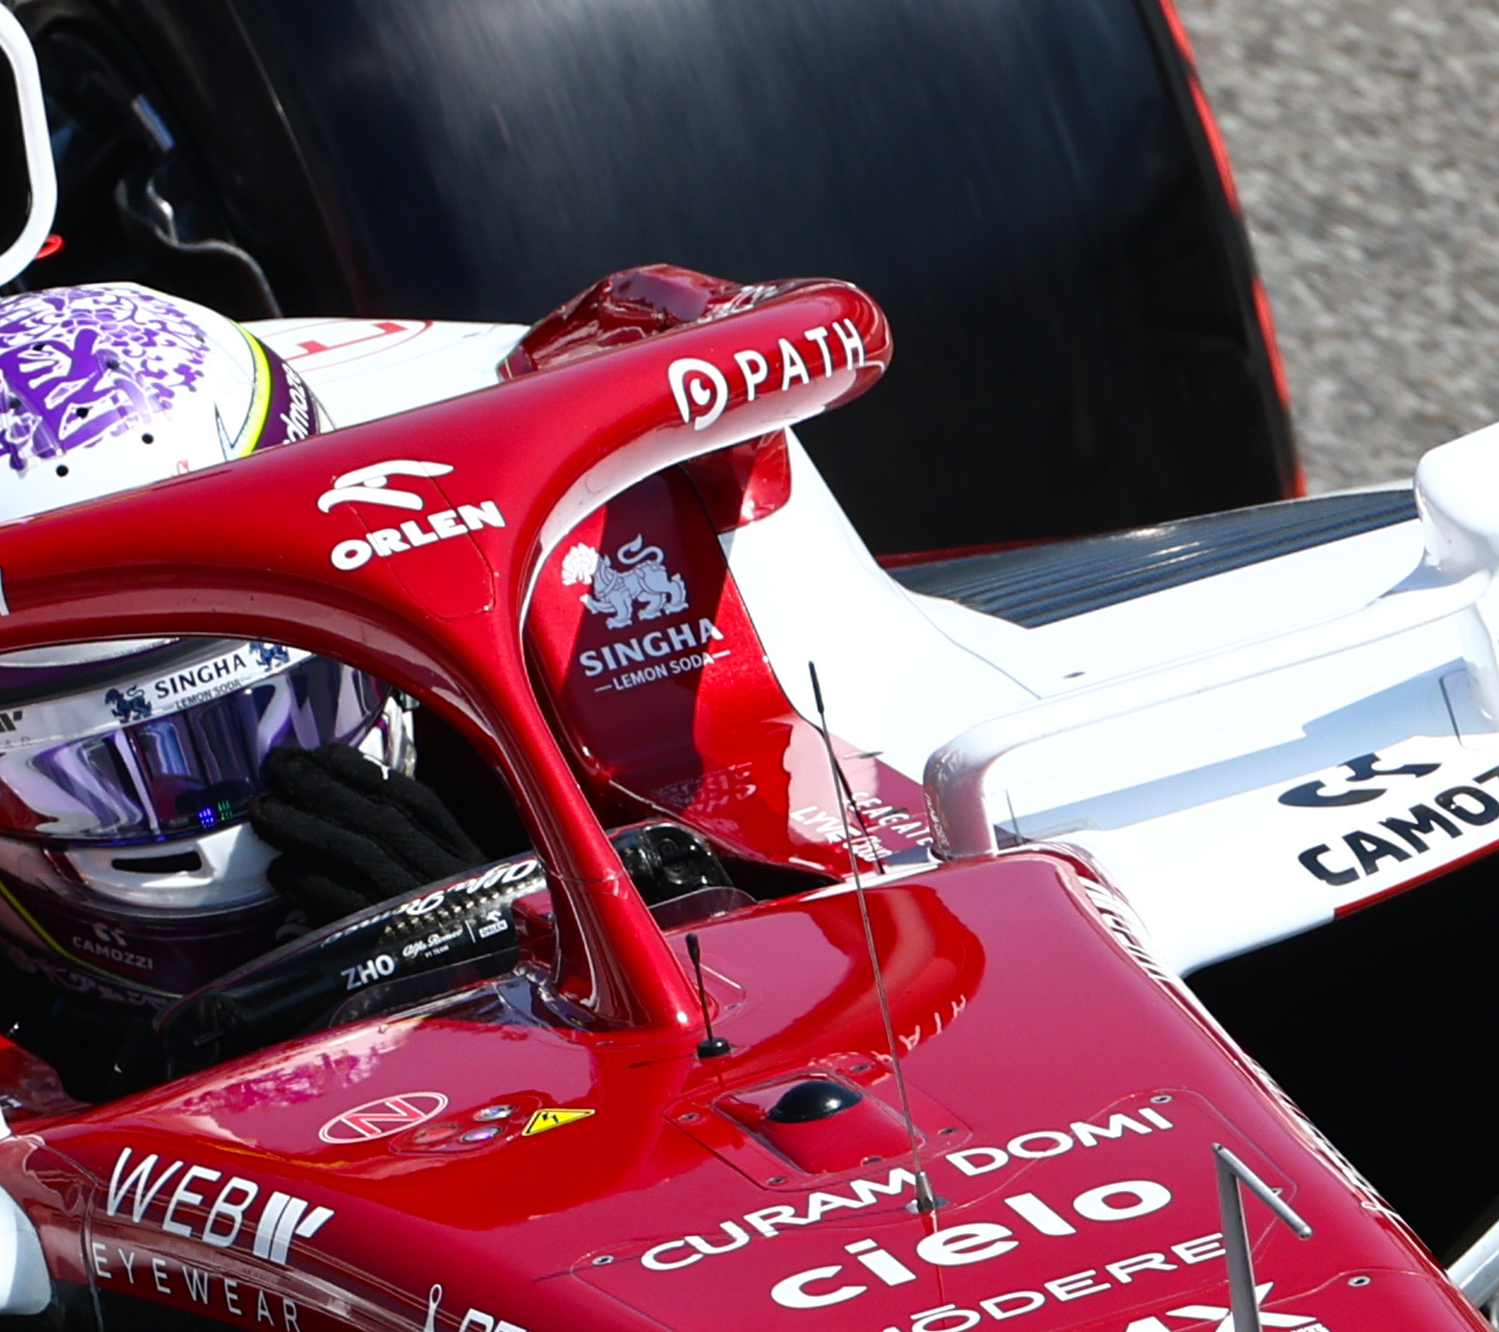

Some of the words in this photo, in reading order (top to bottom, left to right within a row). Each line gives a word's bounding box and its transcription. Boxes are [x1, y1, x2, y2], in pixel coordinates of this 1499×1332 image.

[740, 317, 866, 406] PATH
[330, 500, 507, 572] ORLEN
[155, 652, 248, 700] SINGHA
[577, 616, 726, 678] SINGHA
[612, 664, 670, 692] LEMON
[671, 653, 714, 678] SODA
[72, 934, 155, 972] CAMOZZI
[340, 953, 396, 992] ZHO
[944, 1106, 1174, 1177] DOMI
[105, 1146, 260, 1249] WEB
[640, 1166, 918, 1273] CURAM
[769, 1178, 1174, 1310] cielo
